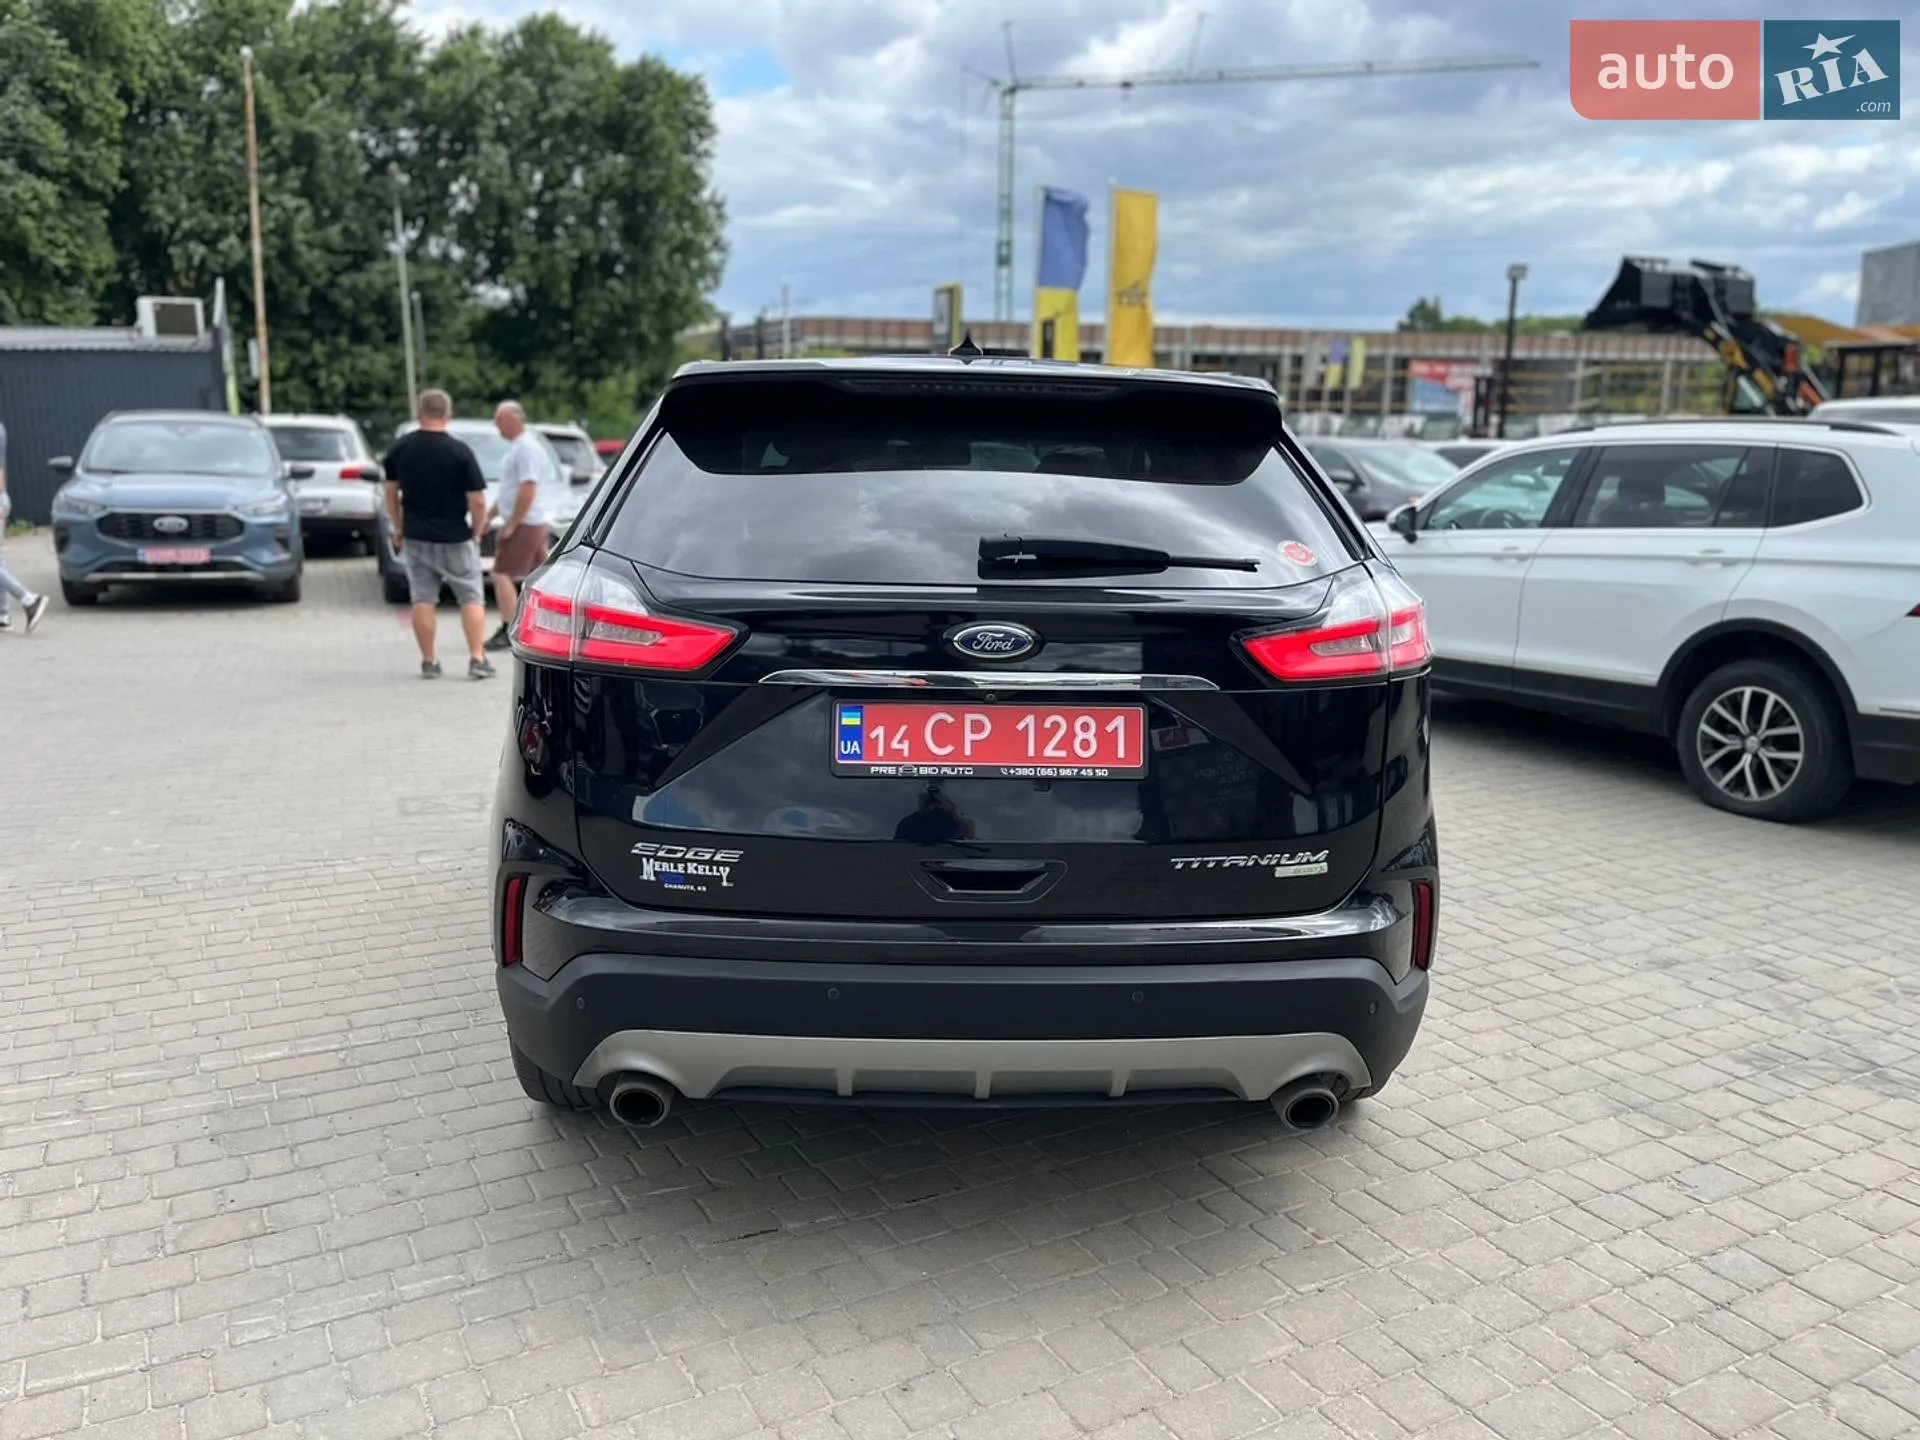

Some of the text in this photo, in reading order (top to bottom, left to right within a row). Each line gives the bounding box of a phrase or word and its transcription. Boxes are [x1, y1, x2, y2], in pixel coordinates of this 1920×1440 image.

[972, 631, 1015, 650] Ford
[869, 712, 1126, 759] 14 CP 1281
[841, 740, 860, 755] UA
[870, 766, 974, 775] PRE BID AUTO
[630, 841, 744, 863] EDGE
[1171, 850, 1329, 869] TITANIUM
